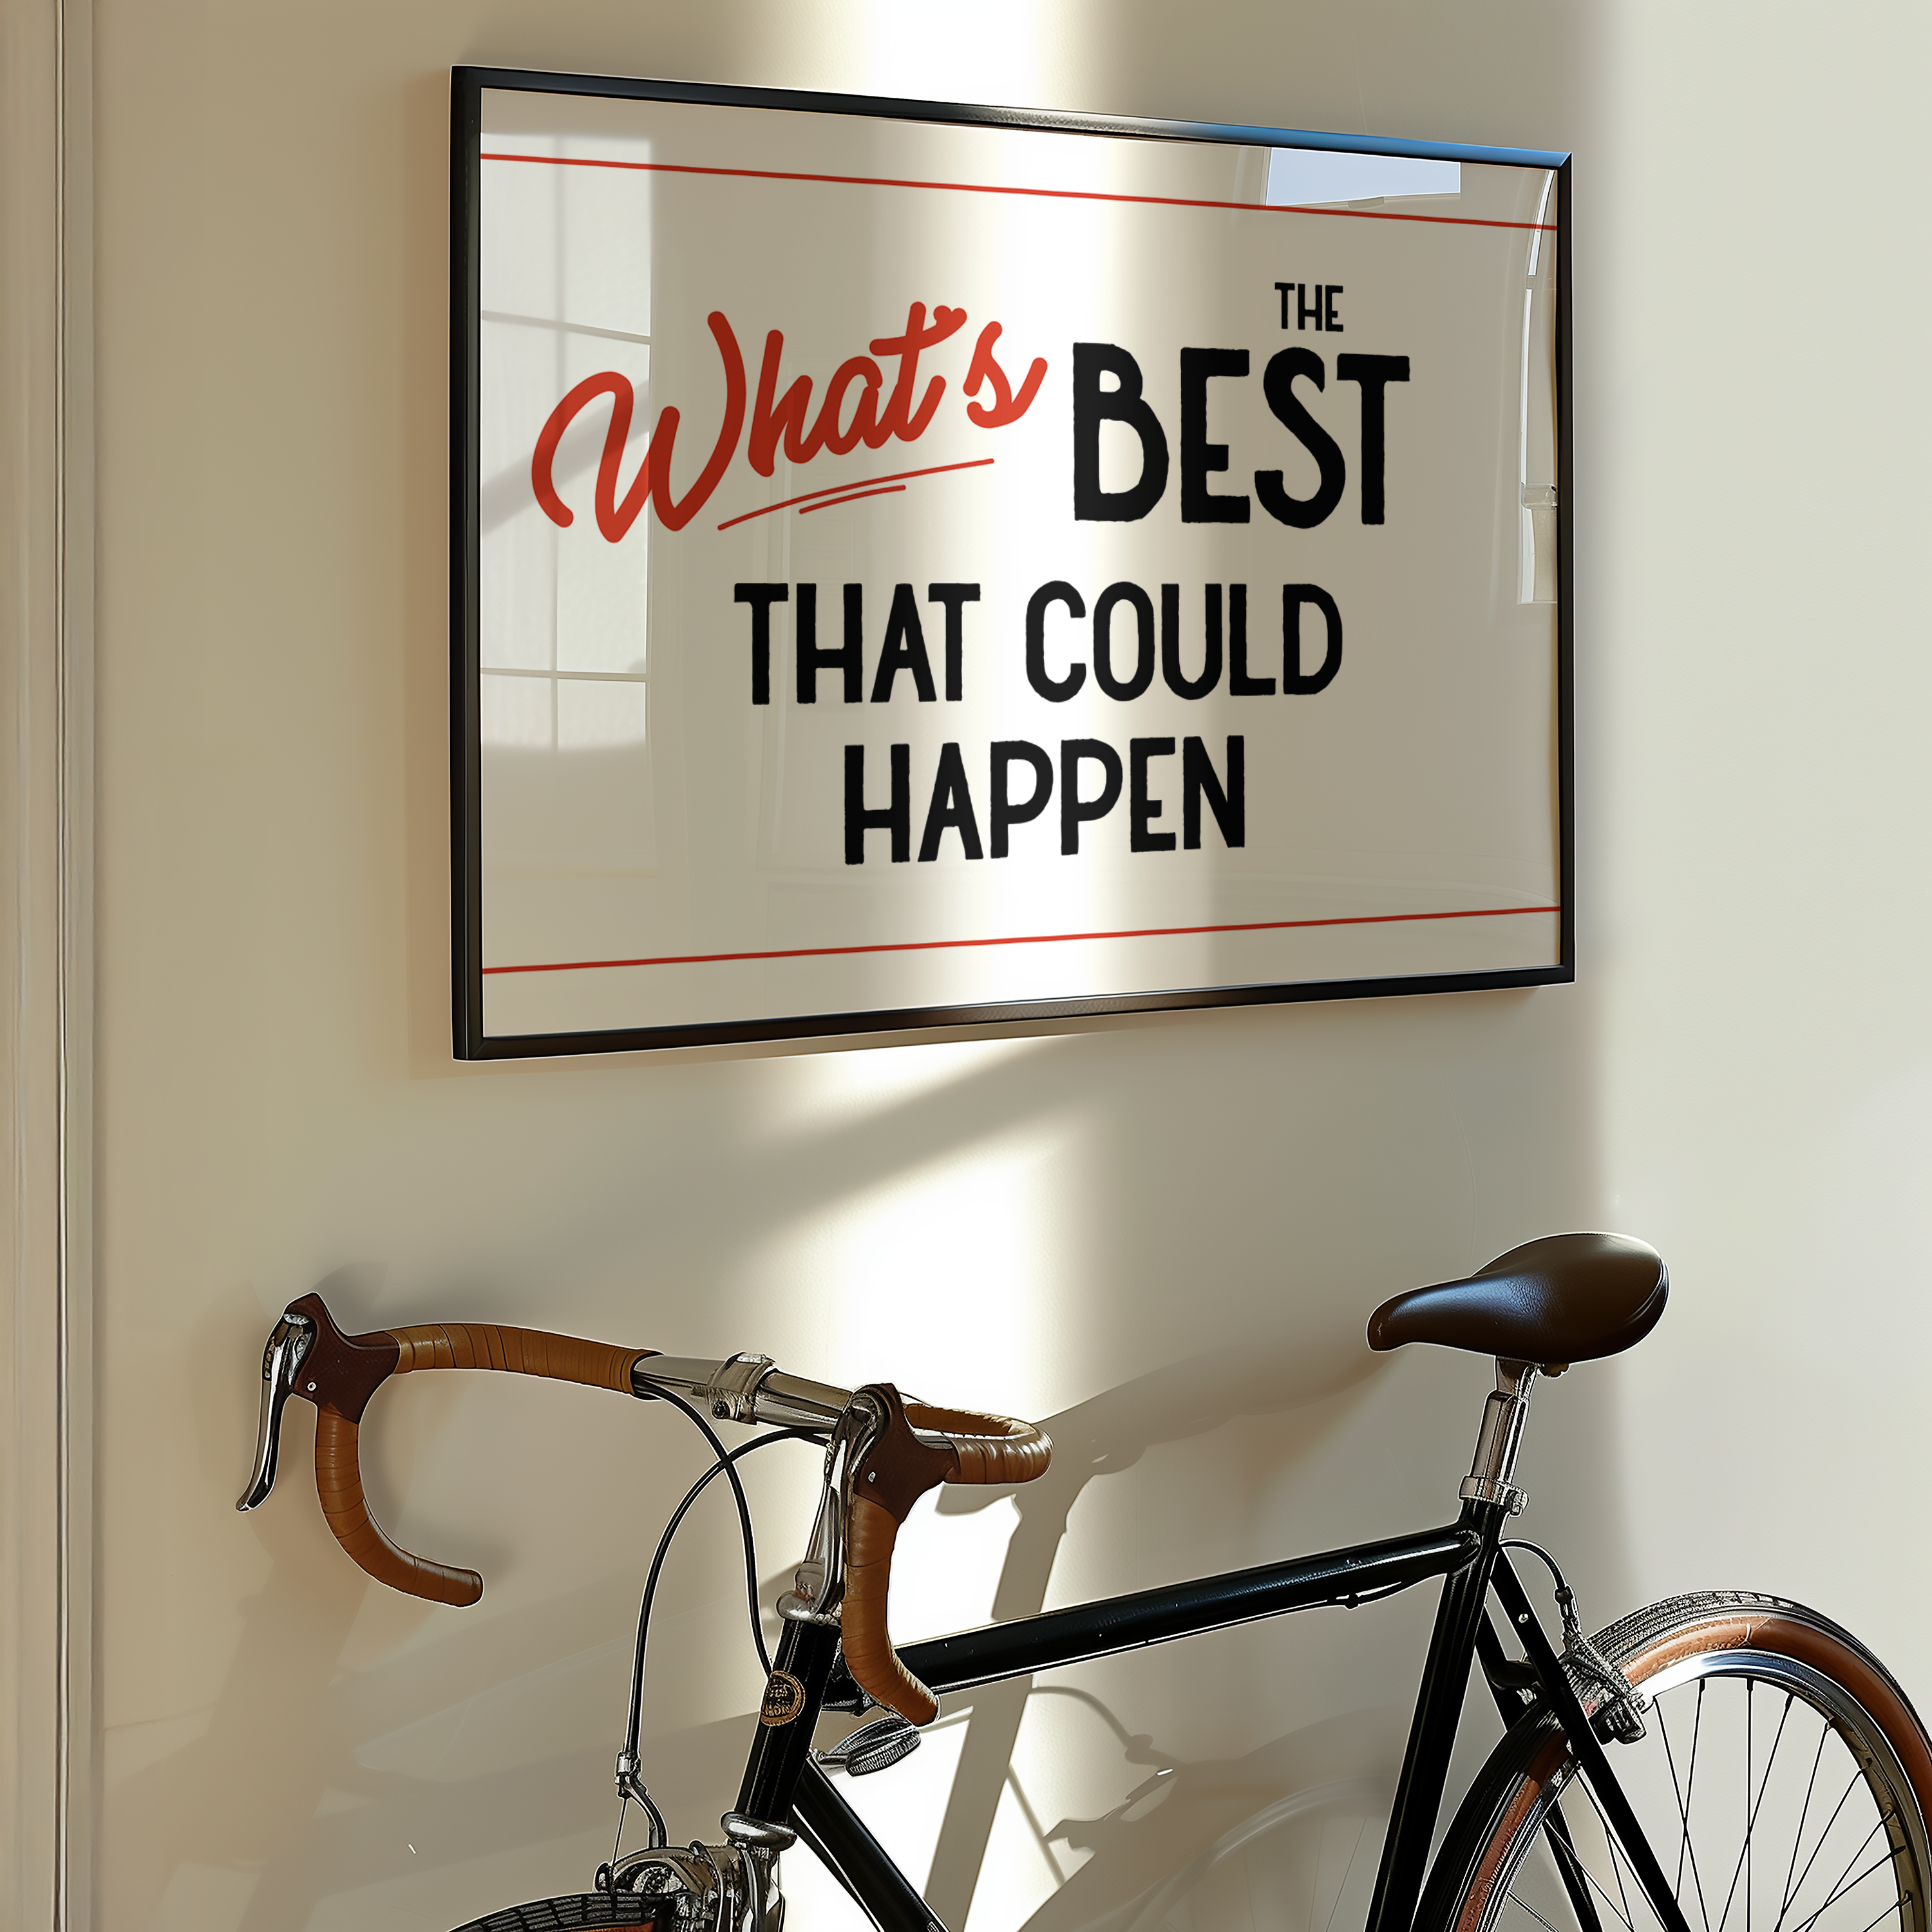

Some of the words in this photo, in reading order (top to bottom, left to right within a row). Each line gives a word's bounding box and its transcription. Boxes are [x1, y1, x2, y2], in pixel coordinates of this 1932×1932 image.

[1274, 282, 1344, 332] THE
[532, 301, 1048, 544] What's
[1073, 342, 1411, 529] BEST
[734, 582, 981, 705] THAT
[1026, 581, 1343, 702] COULD
[844, 735, 1245, 866] HAPPEN
